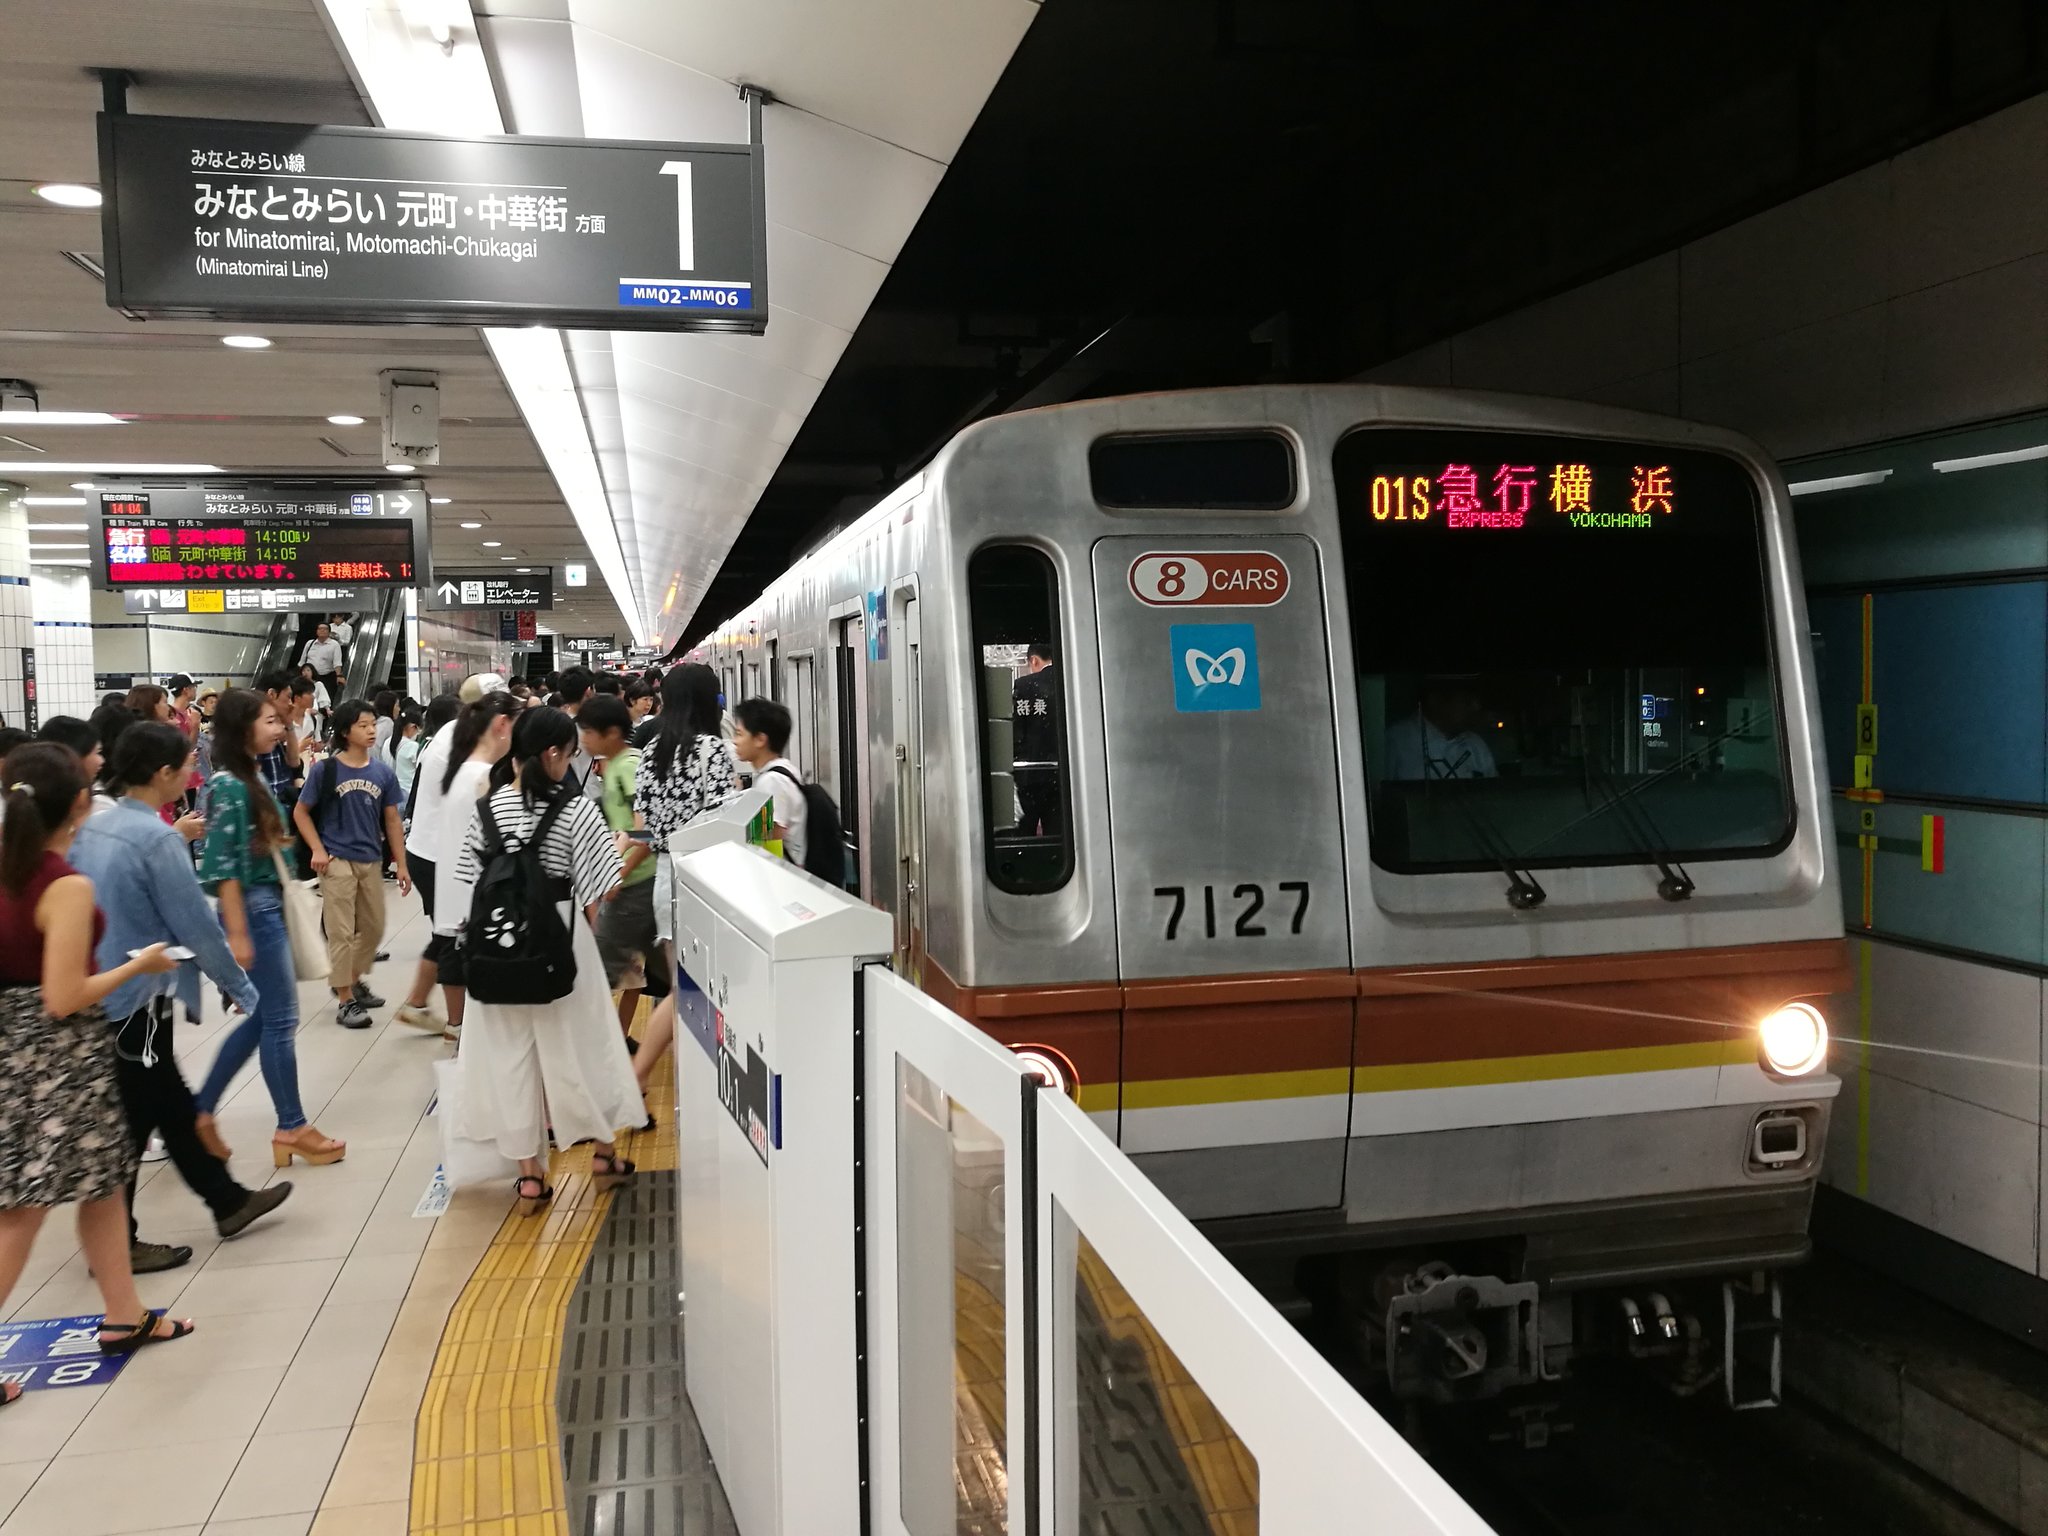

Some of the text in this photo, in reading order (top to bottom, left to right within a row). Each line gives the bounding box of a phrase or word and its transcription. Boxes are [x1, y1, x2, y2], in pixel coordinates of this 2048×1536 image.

[190, 149, 306, 173] みなとみらい線
[193, 183, 606, 234] みなとみらい 元町・中華街 方面
[658, 160, 694, 271] 1
[194, 228, 218, 248] for
[224, 230, 342, 254] Minatomirai,
[194, 257, 330, 282] (Minatomirai Line)
[633, 287, 739, 306] MM02-MM06
[1371, 477, 1430, 520] 01S
[1435, 463, 1538, 514] 急行
[205, 503, 273, 515] みなとみらい
[275, 503, 337, 516] 元町・中華街
[376, 494, 385, 516] 1
[1448, 512, 1524, 529] EXPRESS
[1569, 513, 1652, 528] YOKOHAMA
[108, 528, 146, 545] 急行
[152, 547, 171, 562] 8両
[256, 547, 296, 561] 14:05
[1157, 561, 1279, 597] 8 CARS
[486, 588, 540, 599] エレベーター
[1154, 882, 1309, 940] 7127
